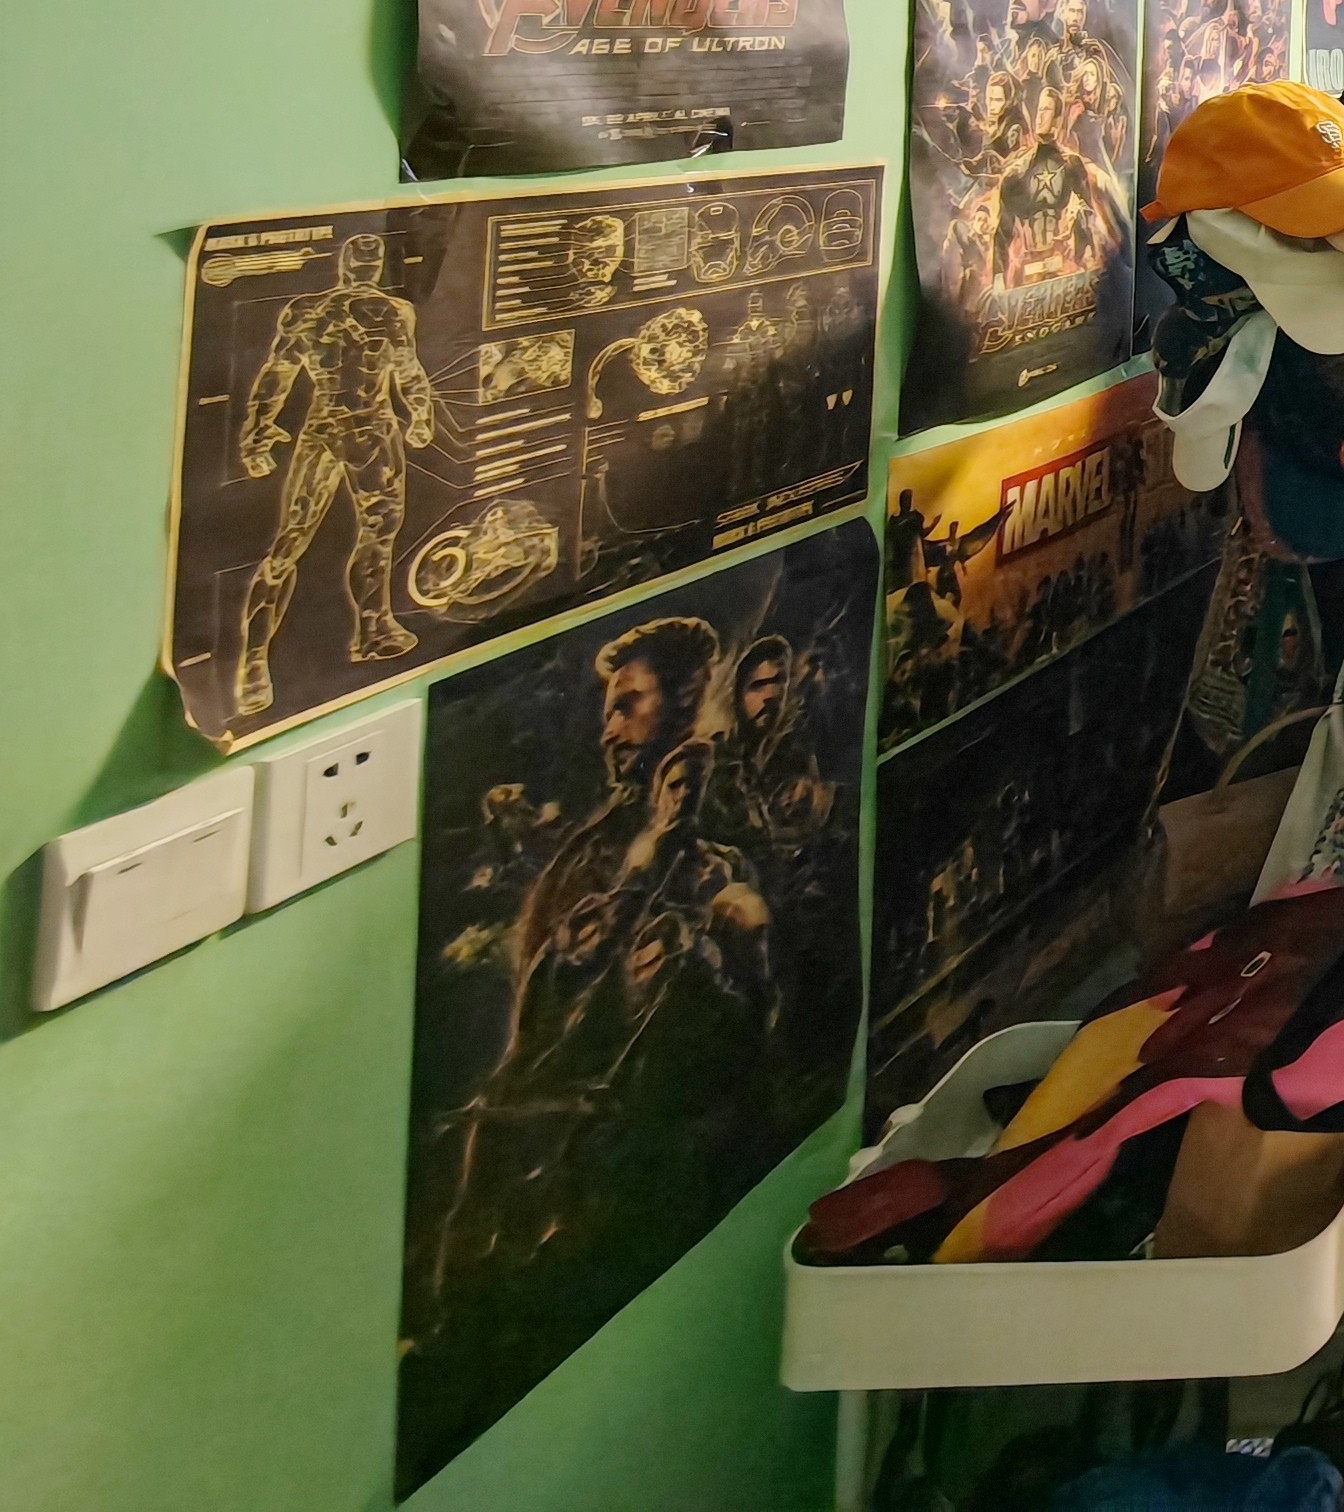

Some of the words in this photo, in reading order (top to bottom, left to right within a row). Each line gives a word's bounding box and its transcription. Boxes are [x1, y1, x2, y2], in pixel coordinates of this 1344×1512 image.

[568, 38, 633, 56] AGE
[642, 37, 684, 55] OF
[690, 34, 787, 54] ULTRON
